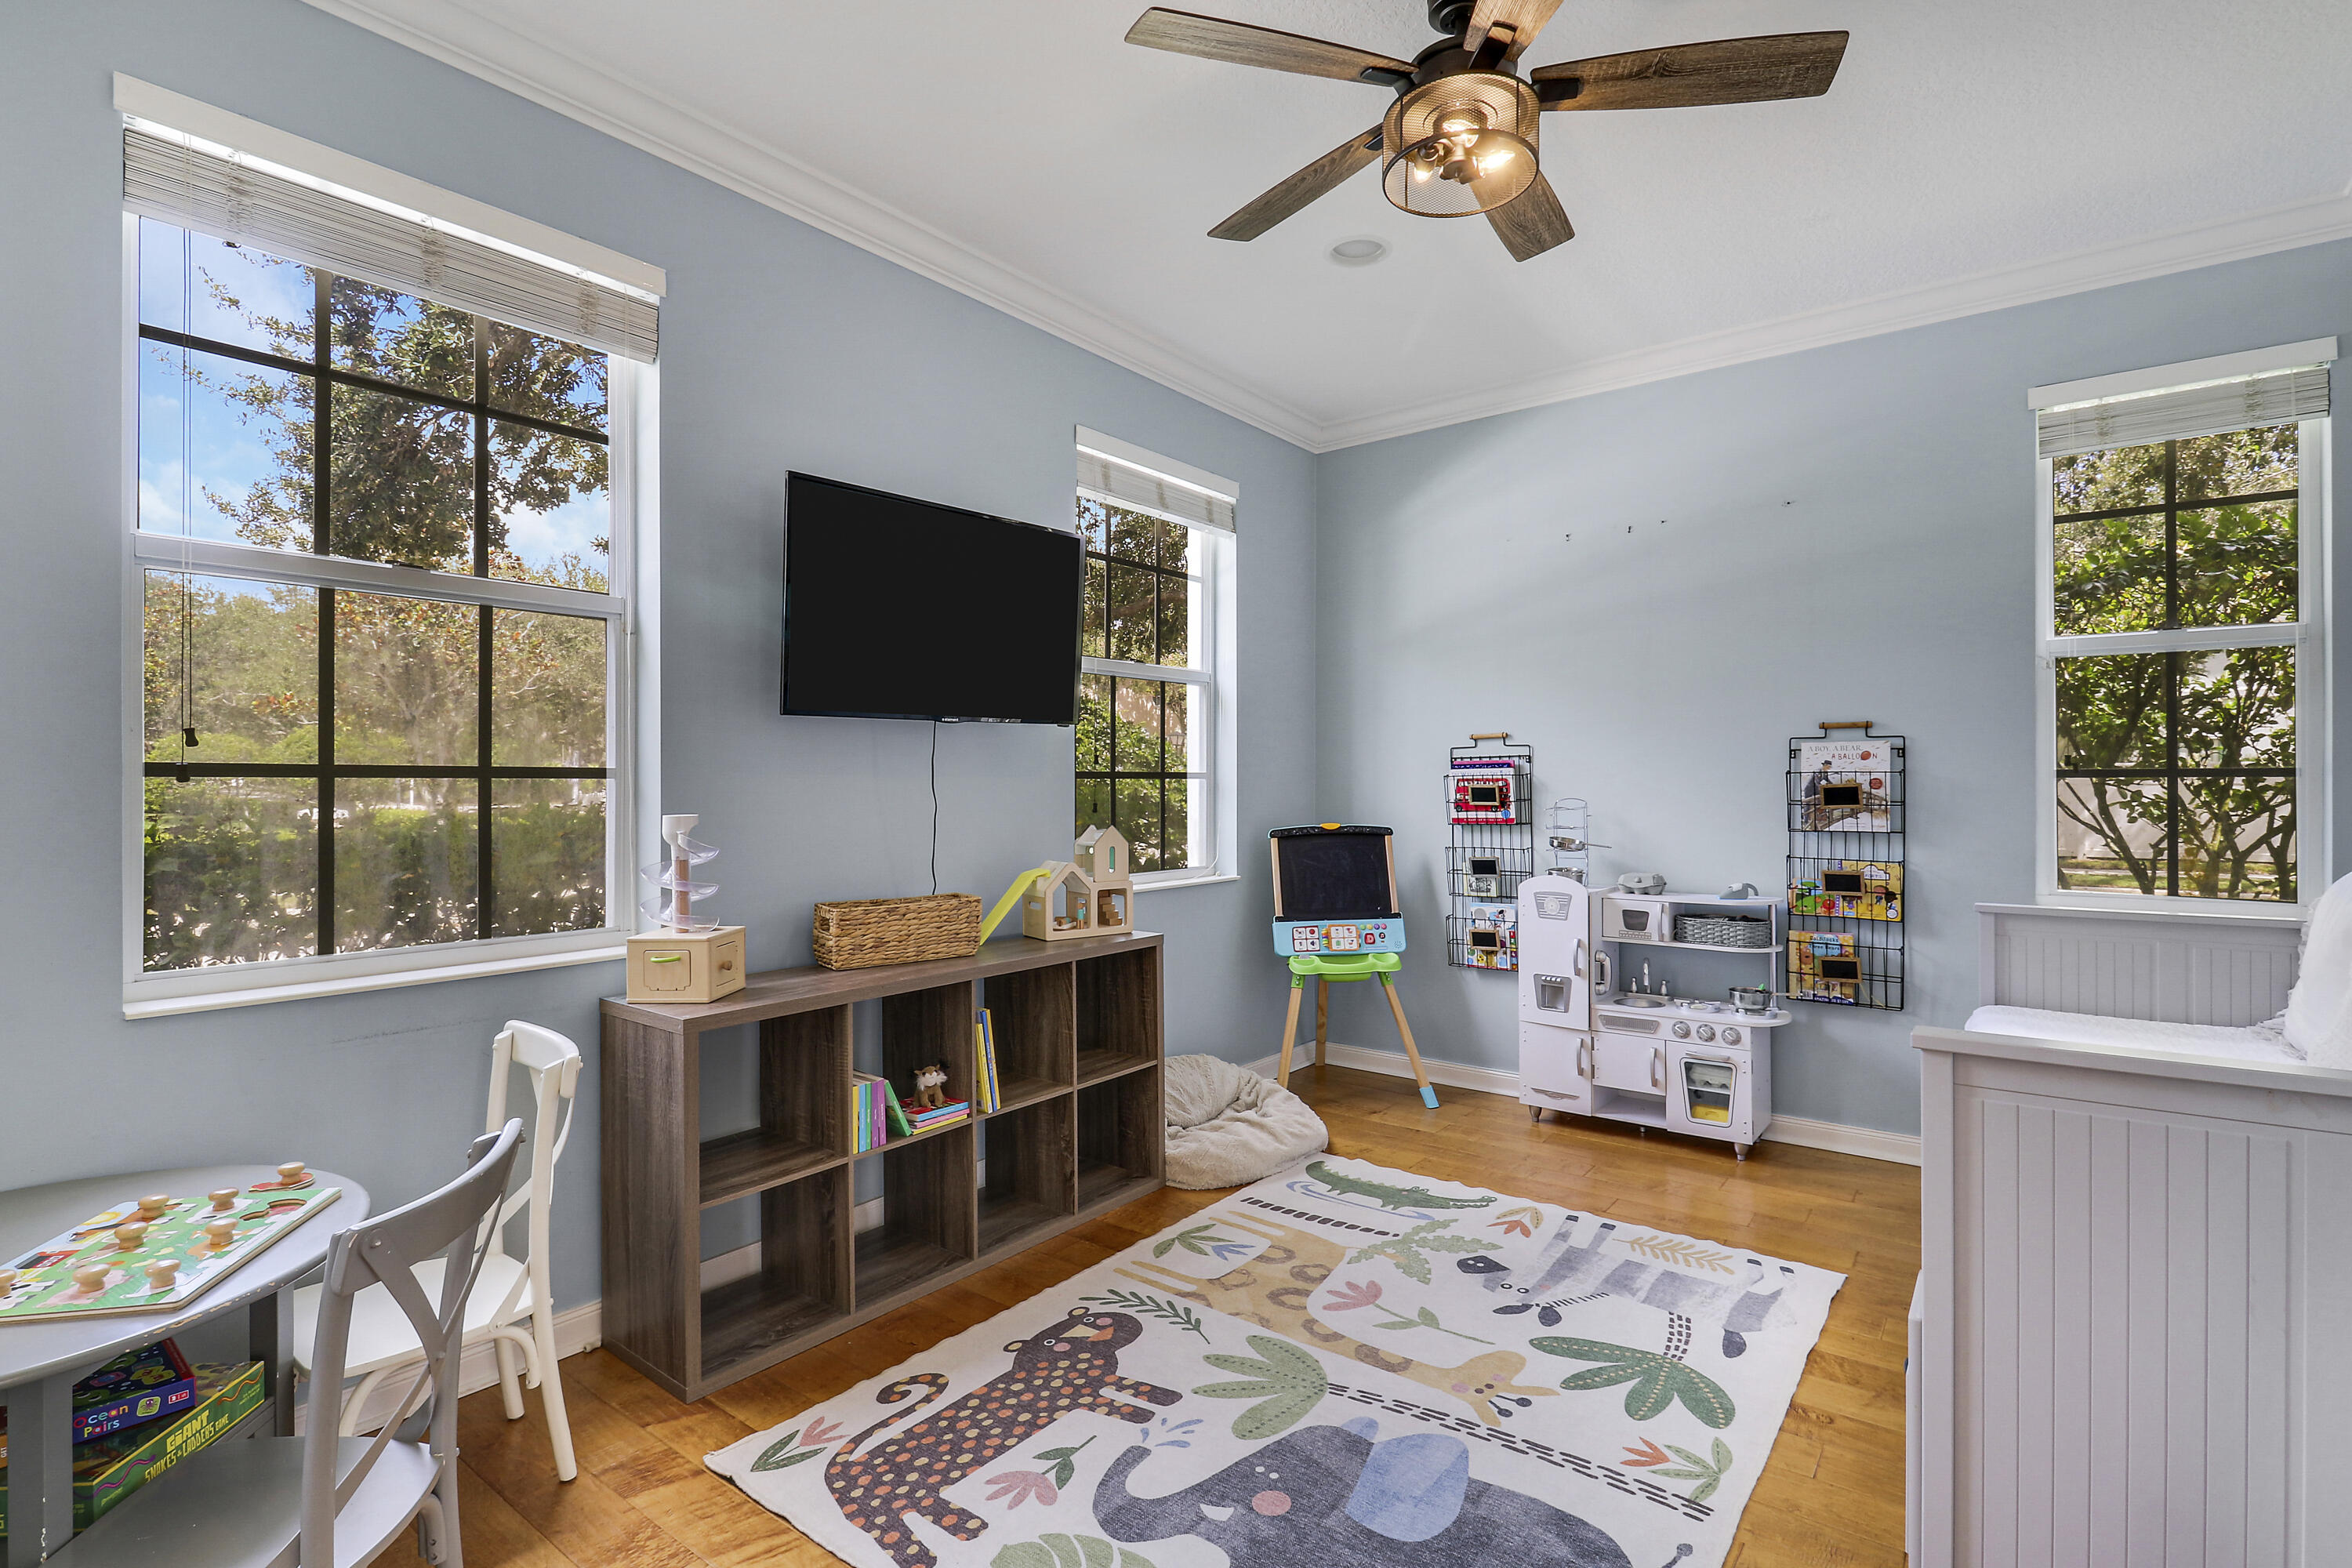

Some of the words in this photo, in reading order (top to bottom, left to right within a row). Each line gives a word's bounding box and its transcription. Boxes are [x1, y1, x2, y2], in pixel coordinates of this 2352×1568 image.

[1367, 935, 1374, 943] D
[74, 1405, 129, 1428] Ocean
[84, 1420, 120, 1438] Pairs
[166, 1409, 209, 1453] GIANT
[145, 1449, 176, 1483] SNAKES
[182, 1421, 215, 1457] LADDERS
[215, 1414, 230, 1431] GAME
